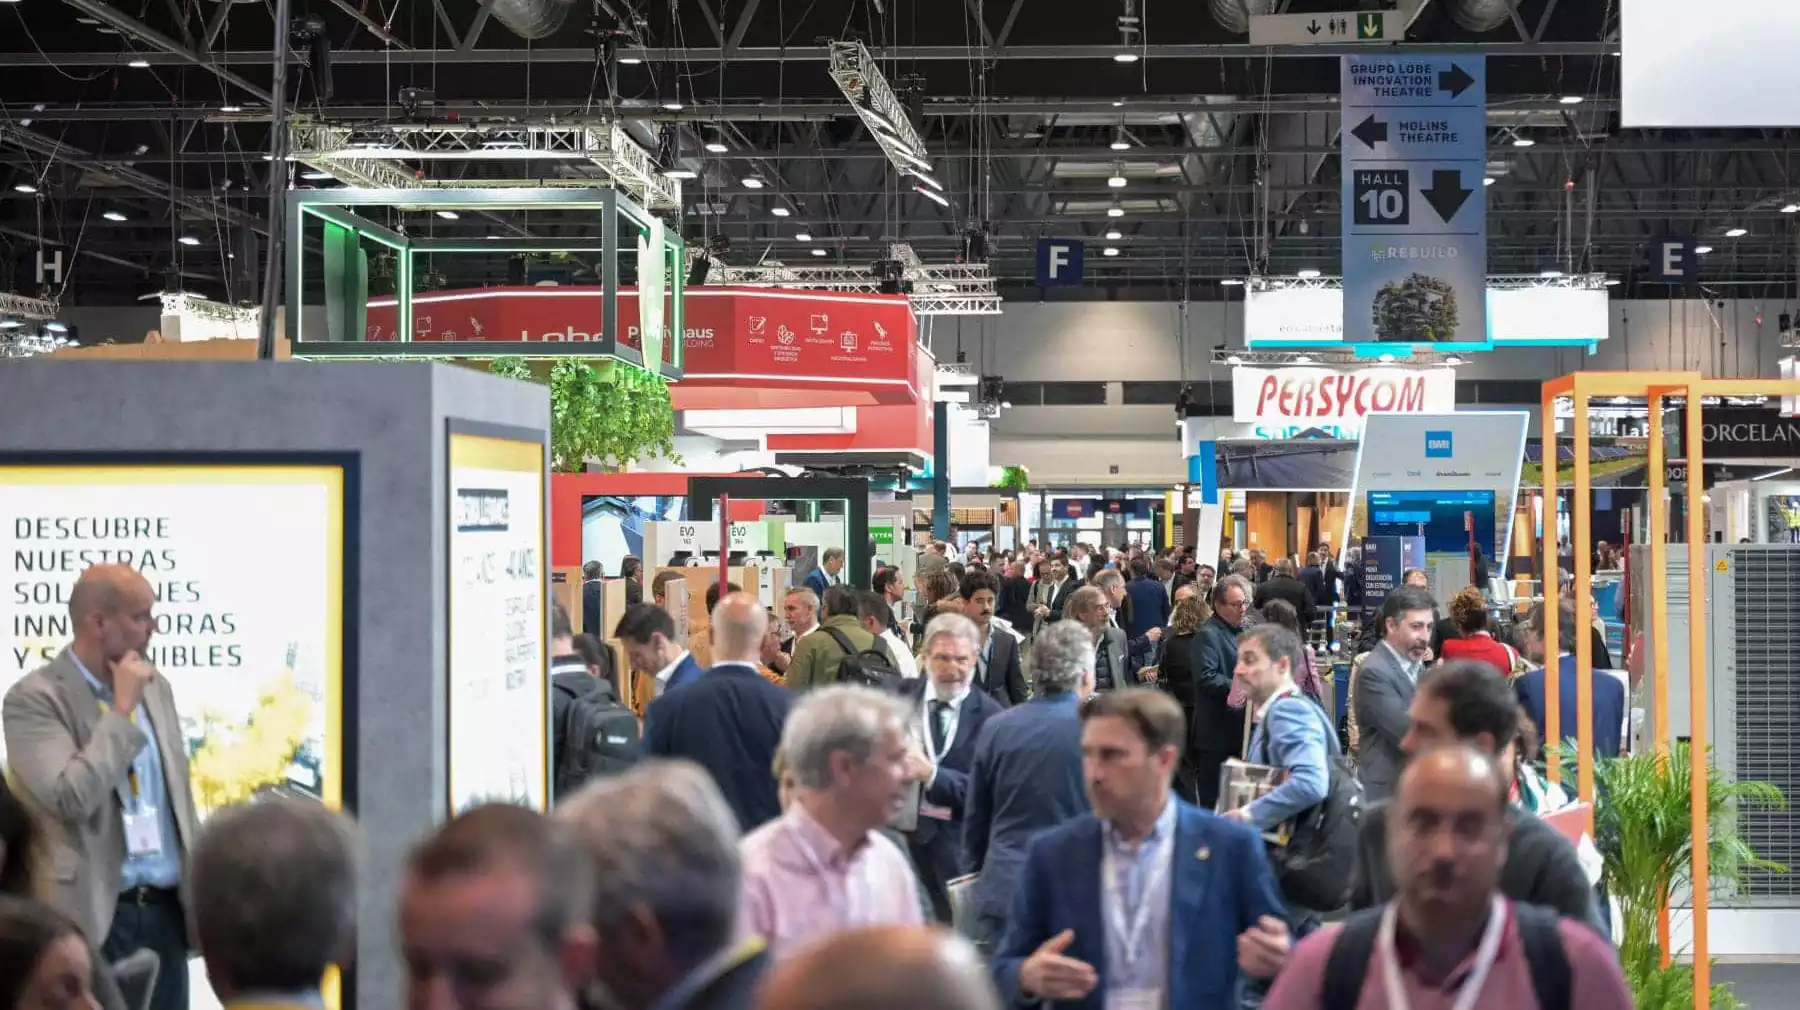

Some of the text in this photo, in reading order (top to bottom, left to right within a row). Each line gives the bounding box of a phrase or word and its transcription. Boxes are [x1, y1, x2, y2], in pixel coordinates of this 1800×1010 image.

[1350, 64, 1432, 74] GRUPO LOBE
[1354, 75, 1432, 86] INNOVATION
[1374, 87, 1433, 97] THEATRE
[1400, 121, 1449, 131] MOLINS
[1400, 132, 1459, 143] THEATRE
[1361, 173, 1403, 185] HALL
[1360, 189, 1404, 219] 10
[1049, 246, 1069, 279] F
[1387, 246, 1459, 259] REBUILD
[1662, 242, 1684, 276] E
[36, 250, 62, 283] H
[1256, 375, 1426, 417] PERSYCOM
[15, 517, 170, 540] DESCUBRE
[14, 613, 237, 637] INNORAS
[13, 646, 31, 669] Y
